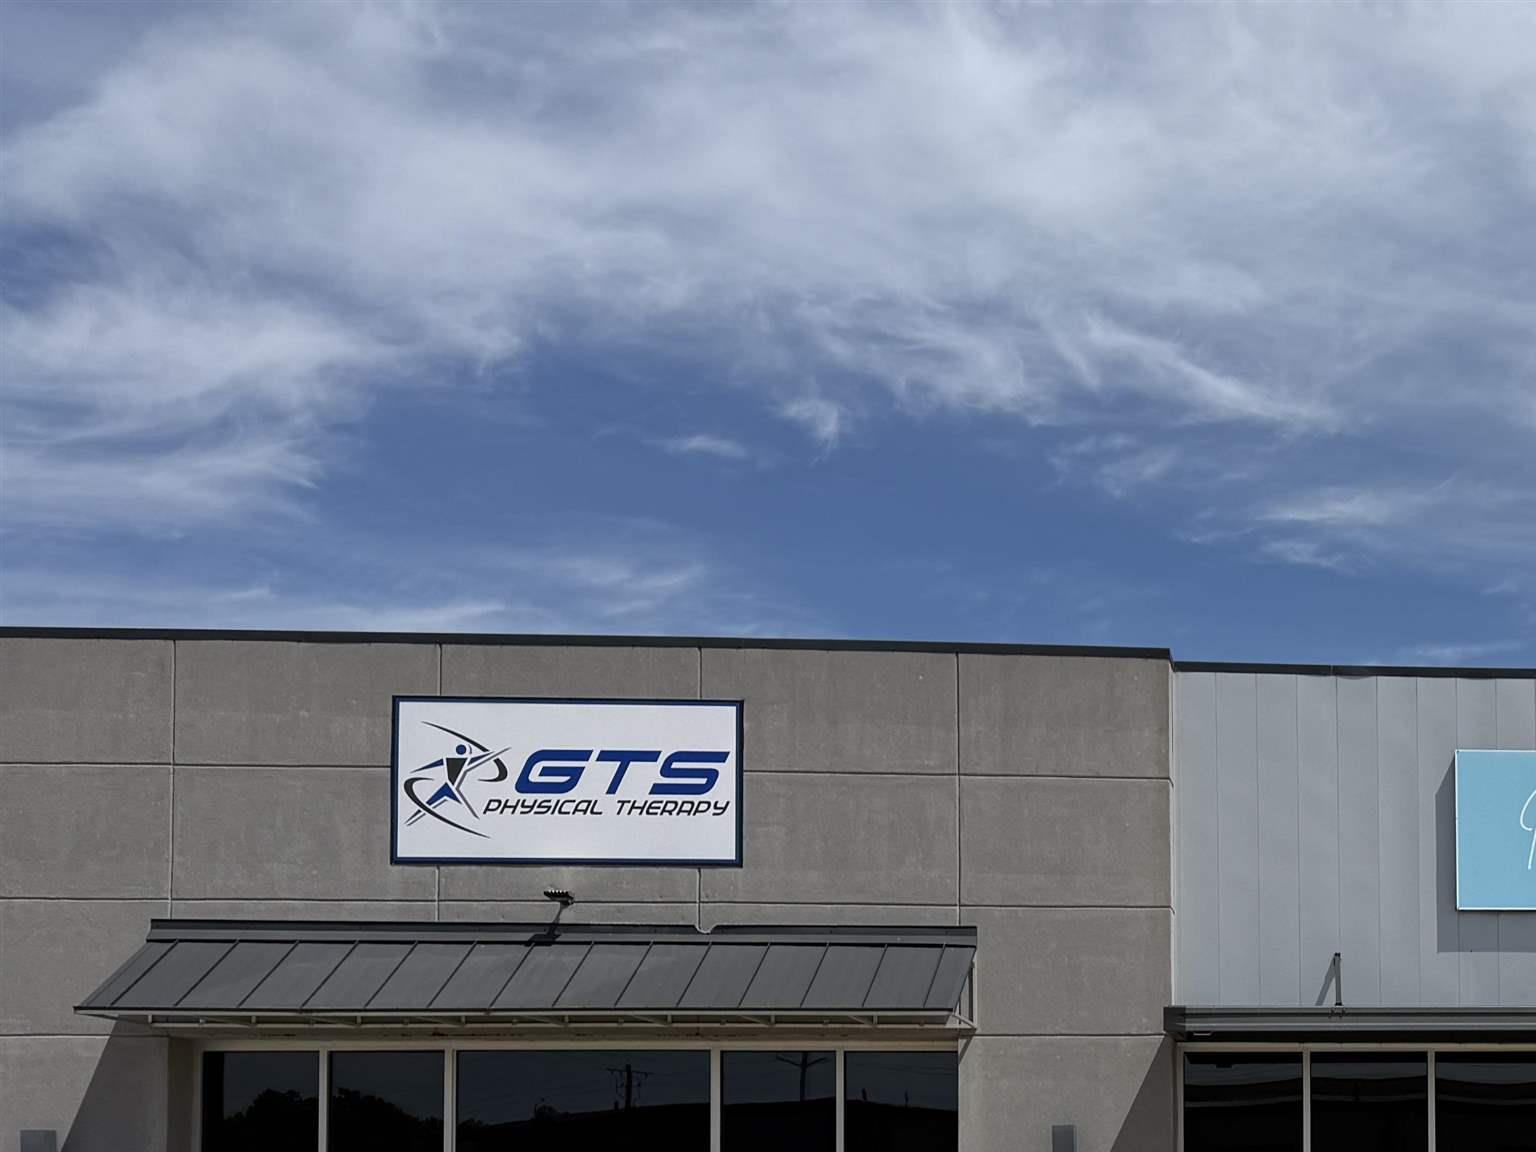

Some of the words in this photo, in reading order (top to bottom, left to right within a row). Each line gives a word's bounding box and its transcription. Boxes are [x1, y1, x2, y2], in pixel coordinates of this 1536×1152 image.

[515, 749, 730, 795] GTS
[483, 798, 603, 816] PHYSICAL
[616, 800, 730, 817] THERAPY
